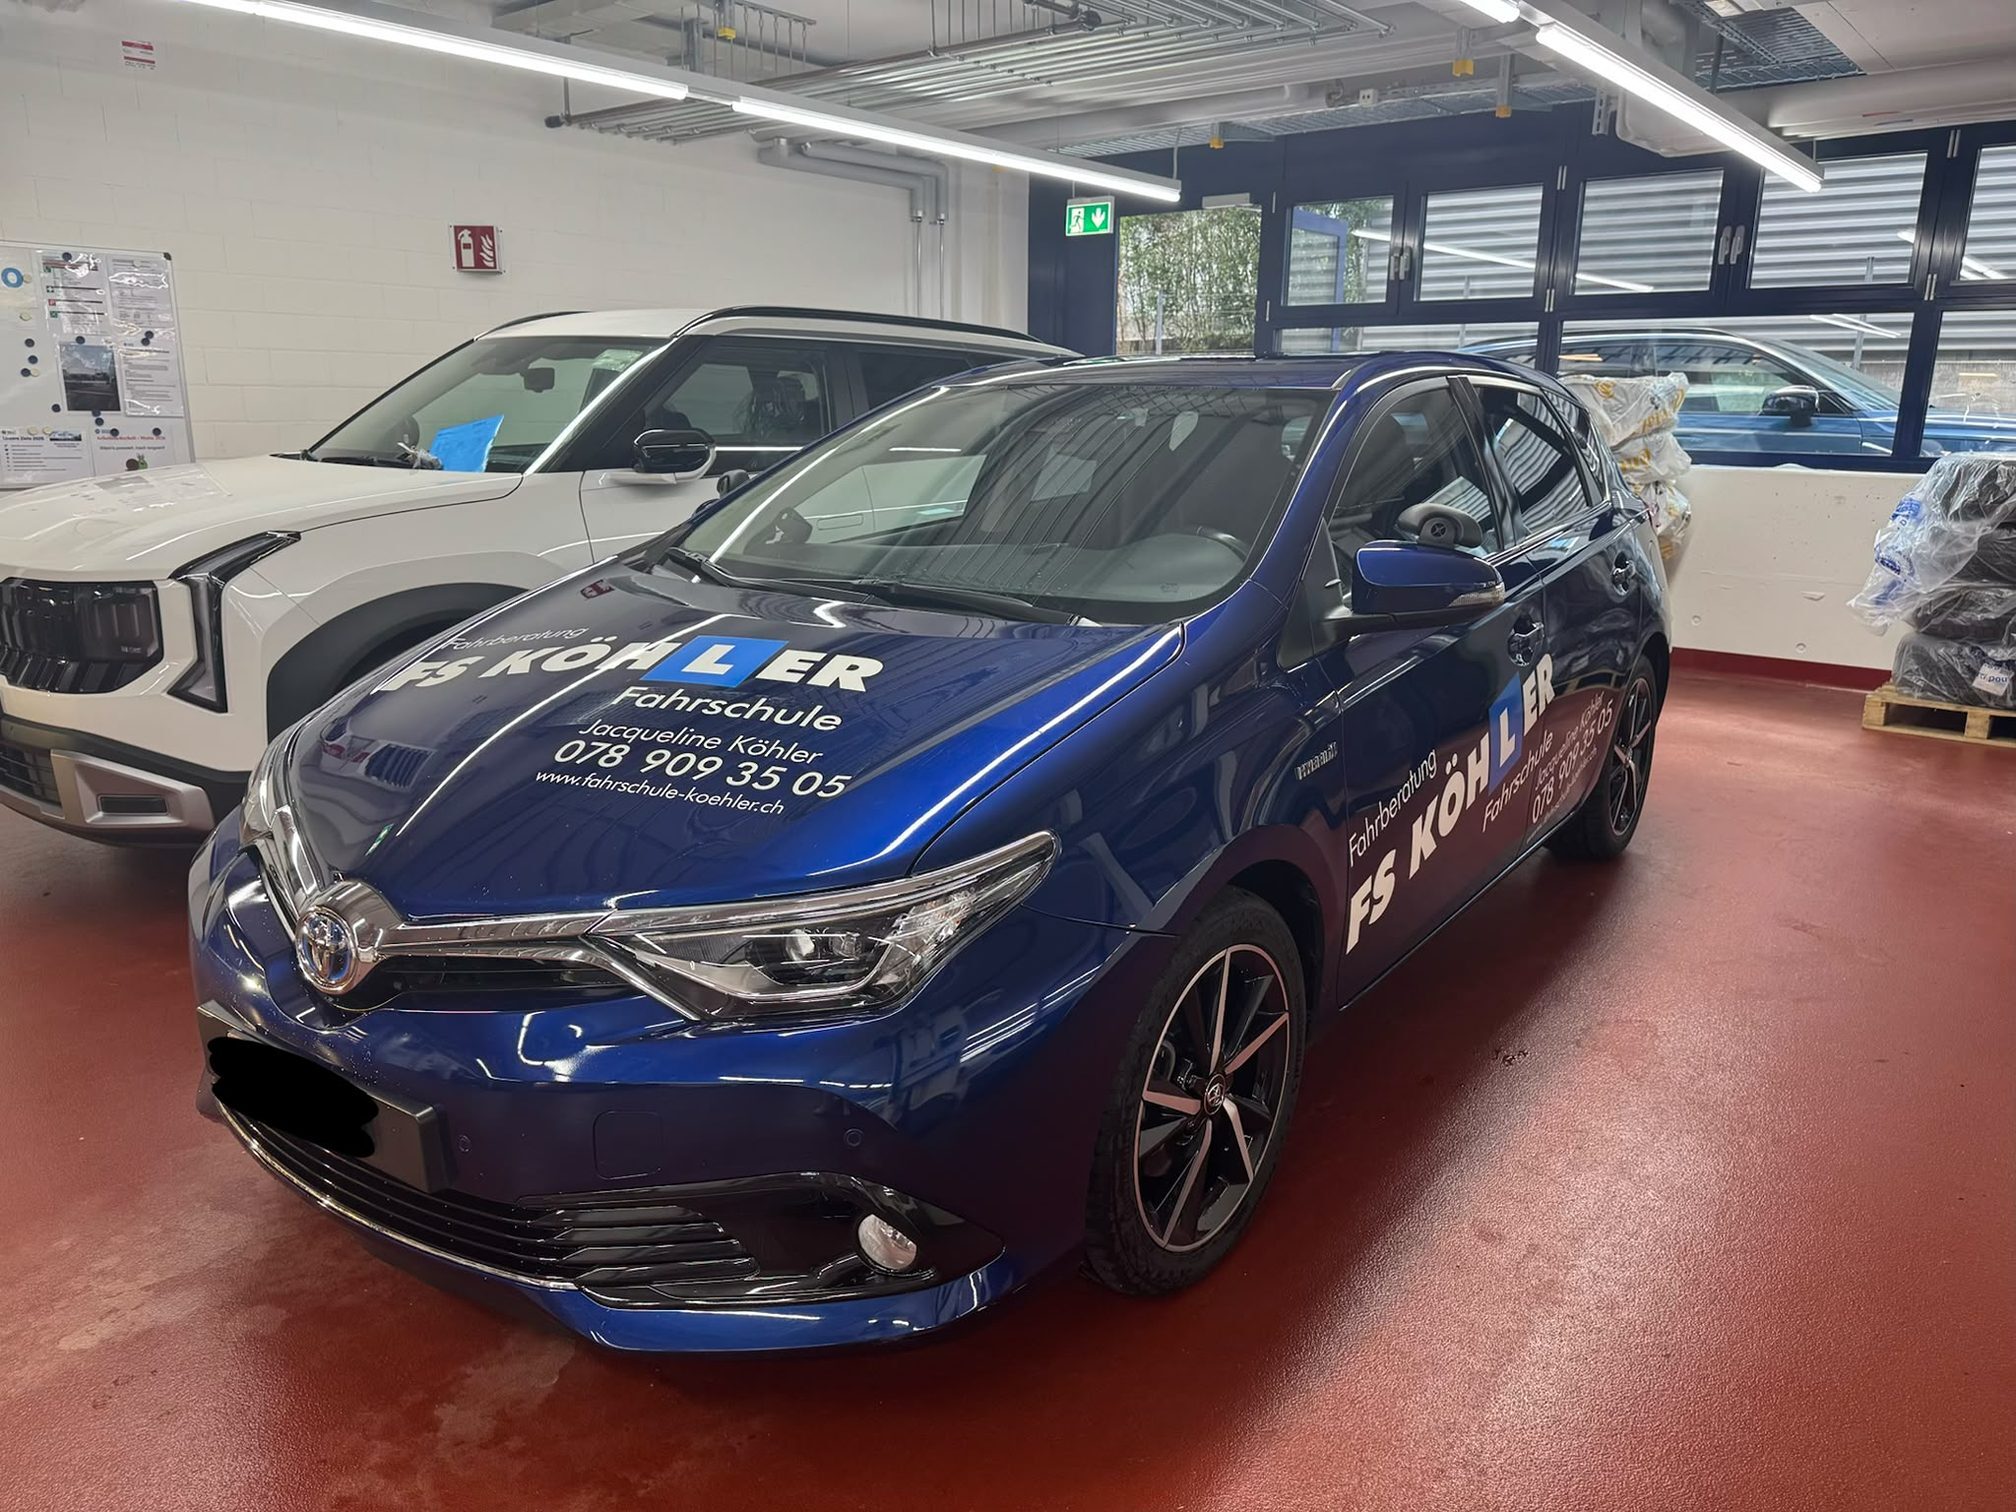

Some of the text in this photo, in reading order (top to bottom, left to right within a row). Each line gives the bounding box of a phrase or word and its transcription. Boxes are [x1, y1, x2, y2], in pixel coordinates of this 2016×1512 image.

[380, 636, 884, 692] FS KÖHLER
[441, 625, 588, 650] Fahrberatung
[611, 686, 842, 731] Fahrschule
[554, 739, 852, 798] 078 909 35 05
[579, 719, 823, 765] Jacqueline Köhler
[1532, 700, 1614, 824] 078 909 35 05
[535, 770, 784, 815] www.fahrschule-koehler.ch
[1346, 653, 1556, 955] FS KÖHLER
[1349, 748, 1437, 867] Fahrberatung
[1482, 729, 1553, 832] Fahrschule
